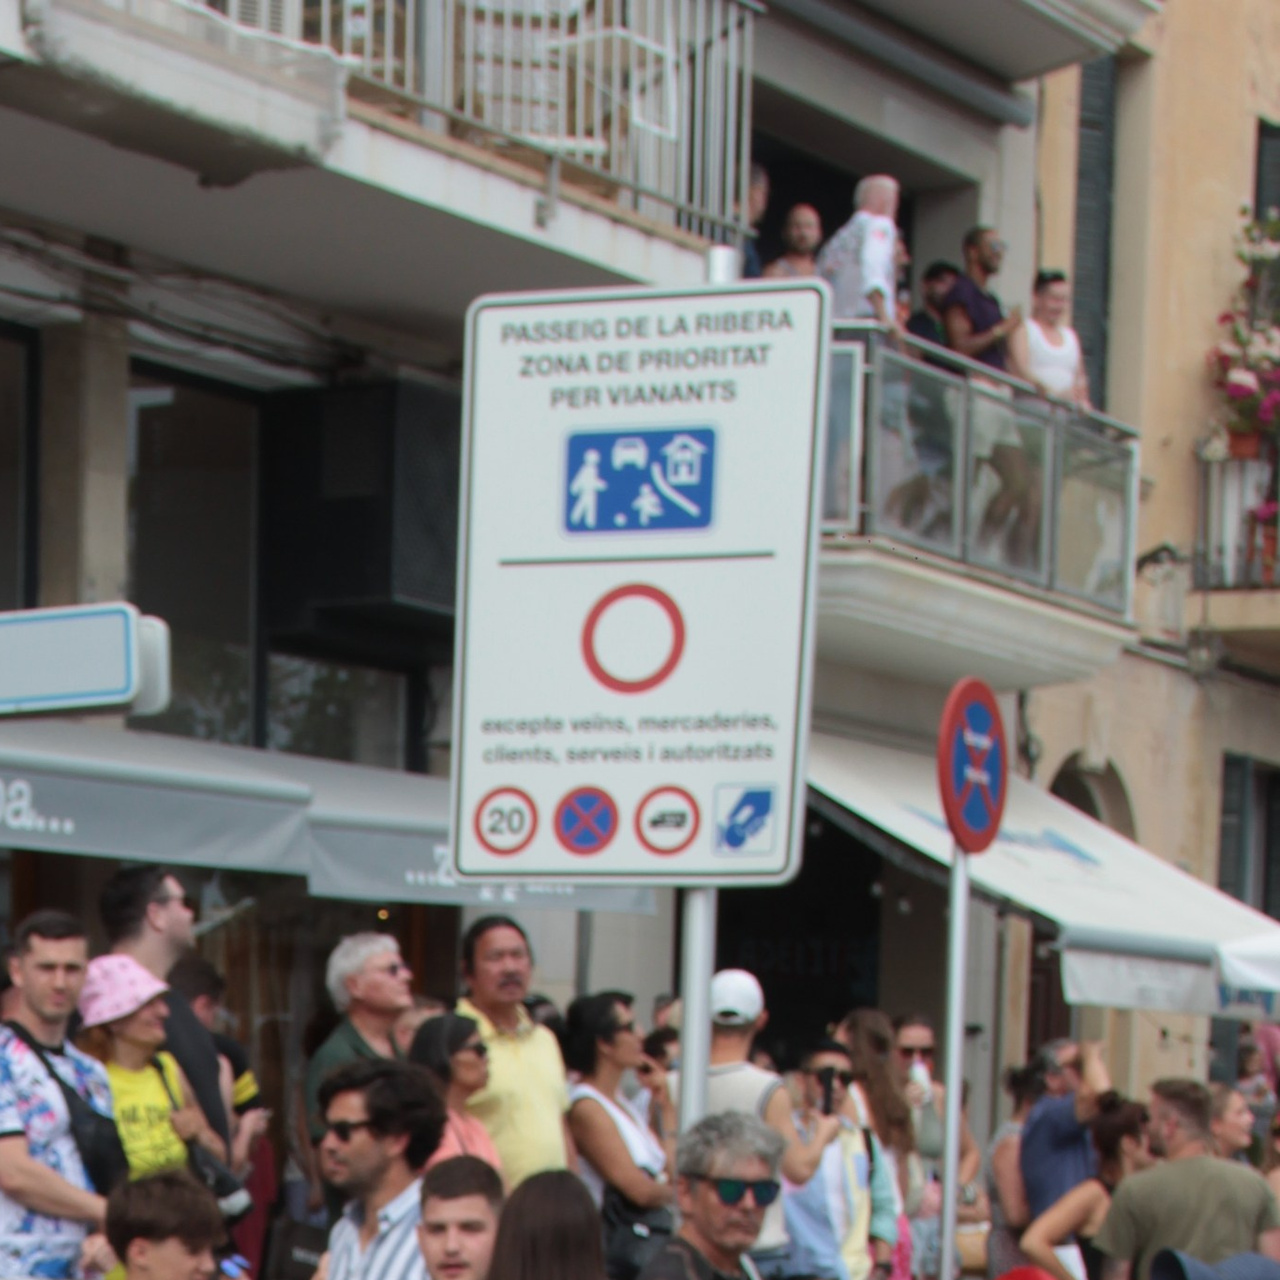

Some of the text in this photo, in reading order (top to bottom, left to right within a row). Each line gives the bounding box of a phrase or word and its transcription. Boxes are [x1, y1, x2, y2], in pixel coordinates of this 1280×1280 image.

[501, 310, 794, 345] PASSEIG DE LA RIBERA
[518, 344, 772, 378] ZONA DE PRIORITAT
[549, 379, 738, 409] PER VIANANTS
[481, 715, 564, 736] excepte
[637, 711, 778, 733] mercaderies,
[482, 740, 775, 765] clients, serveis i autoritzats
[487, 806, 525, 834] 20
